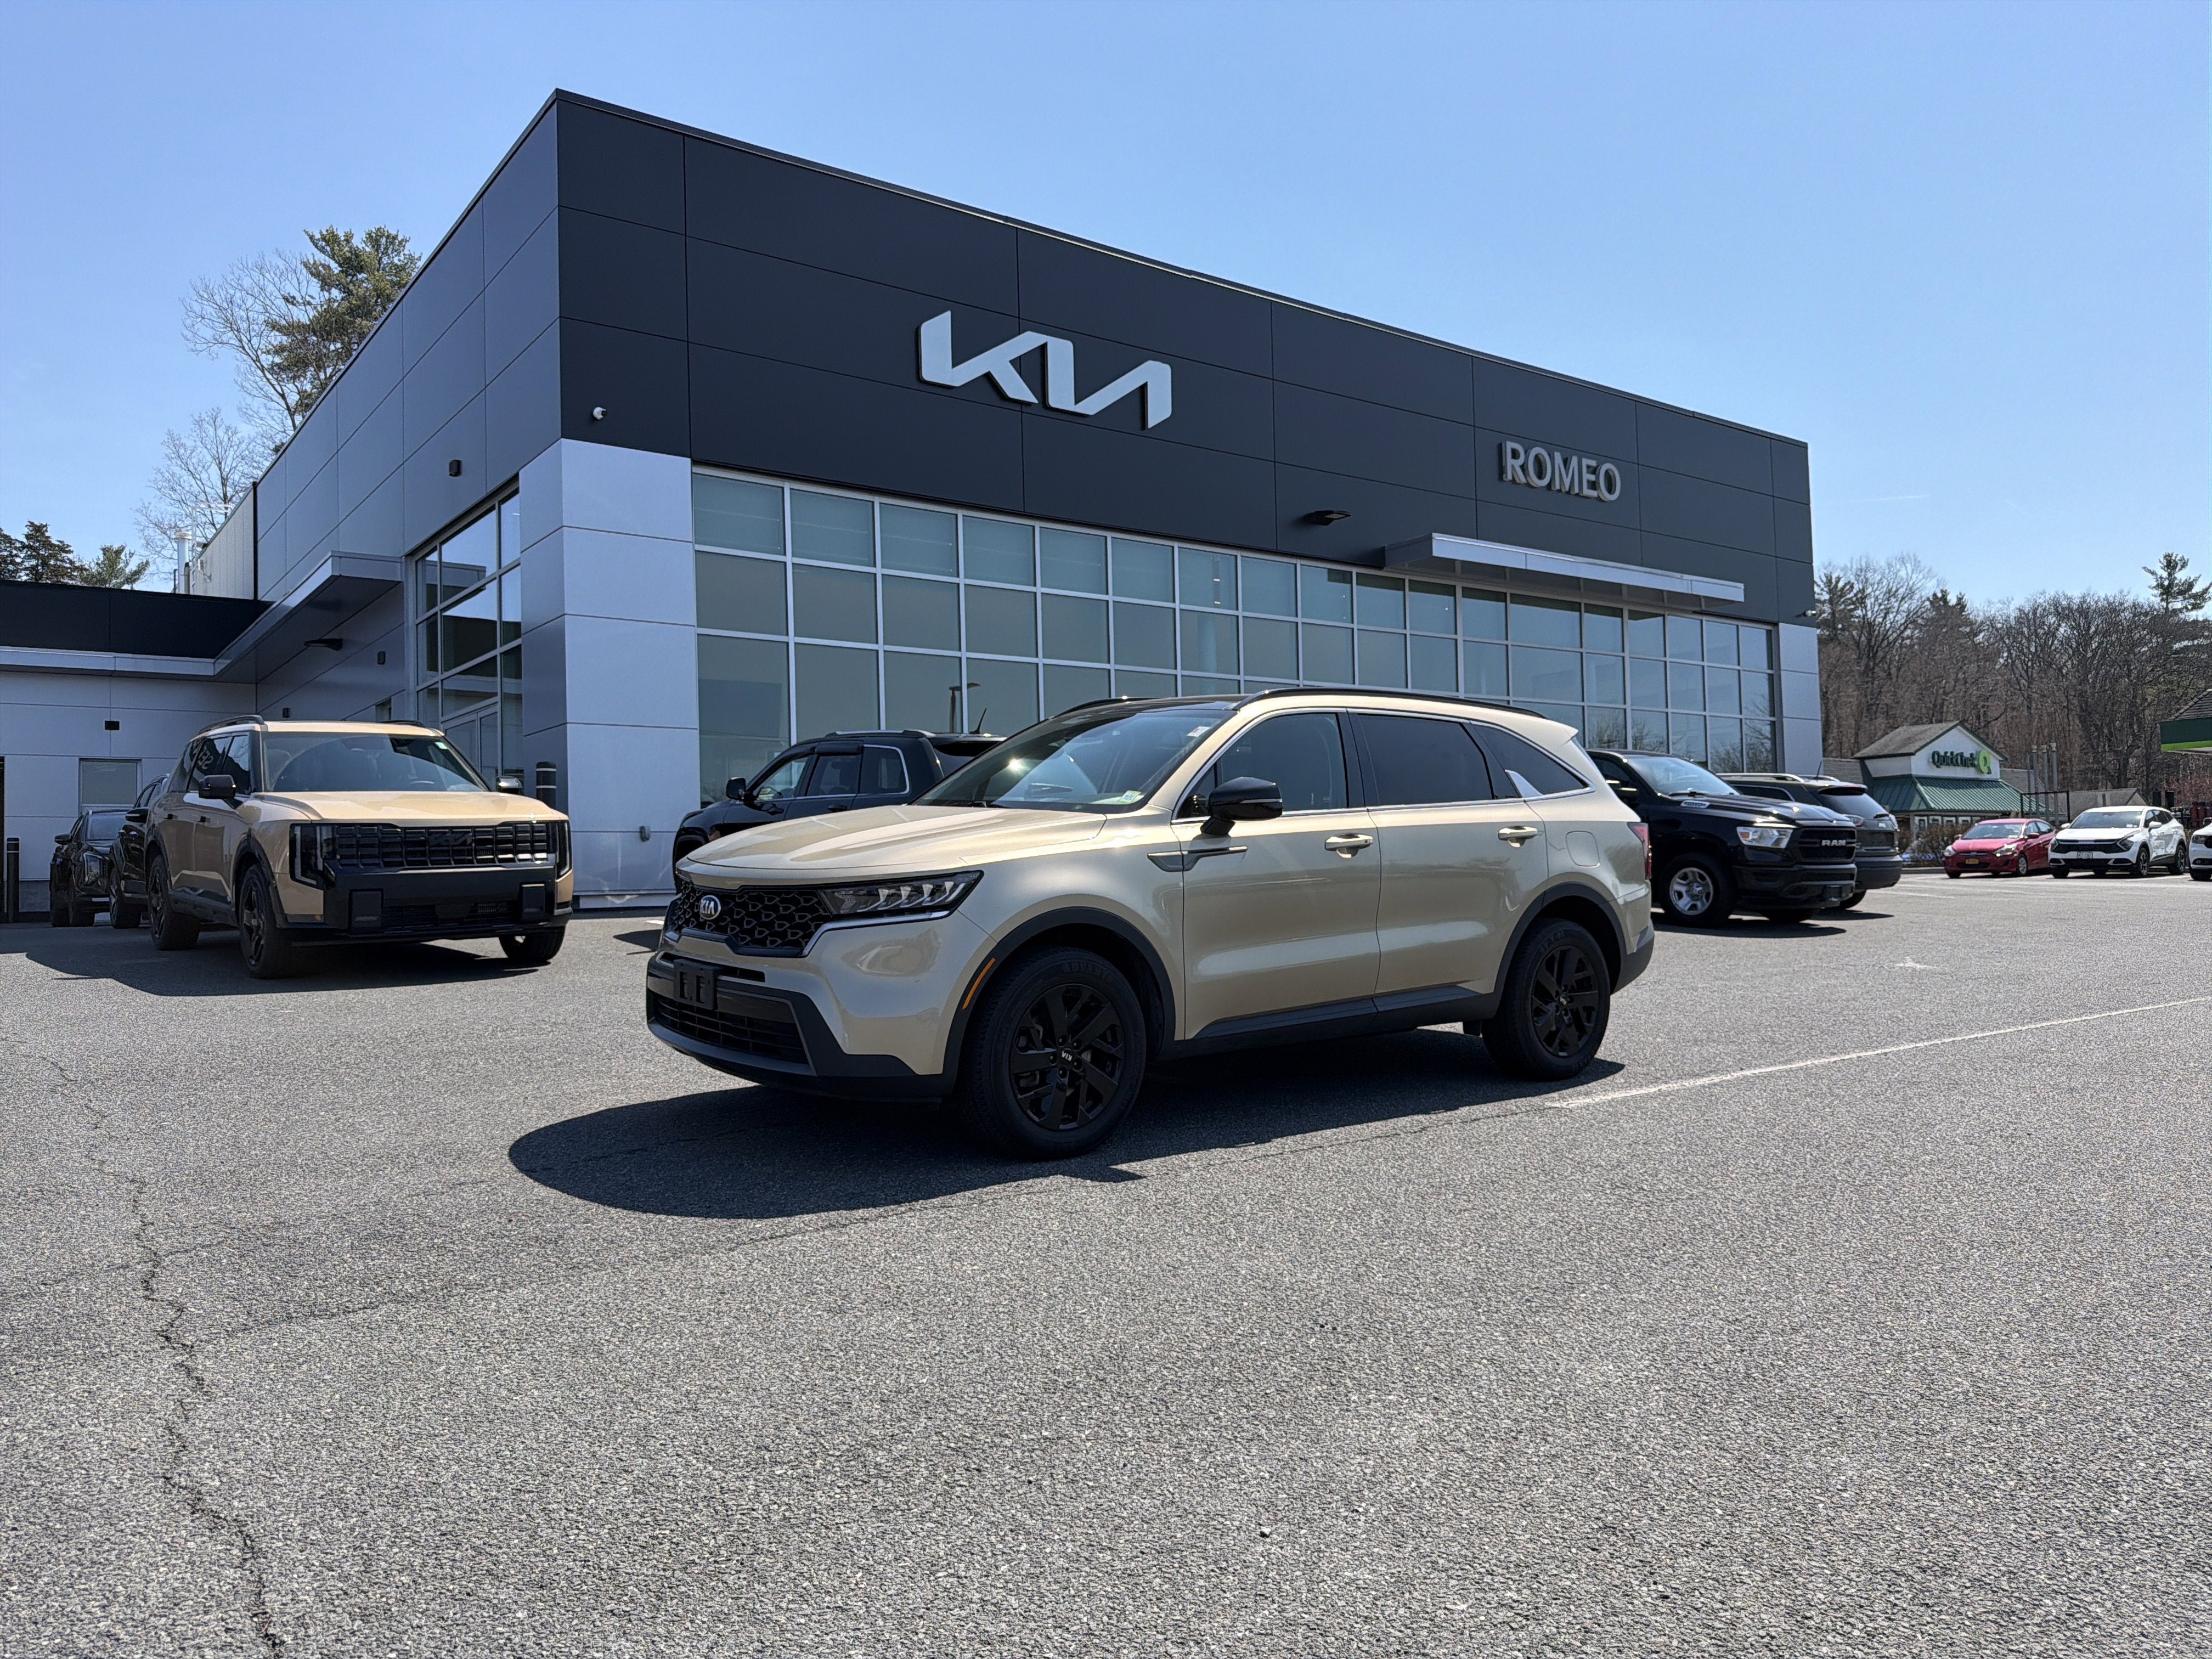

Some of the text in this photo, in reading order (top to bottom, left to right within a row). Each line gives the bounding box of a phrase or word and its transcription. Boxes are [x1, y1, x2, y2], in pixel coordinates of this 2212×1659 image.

[920, 310, 1172, 429] KIA
[1503, 441, 1621, 501] ROMEO
[700, 900, 715, 915] KIA
[1062, 1051, 1073, 1062] KIA
